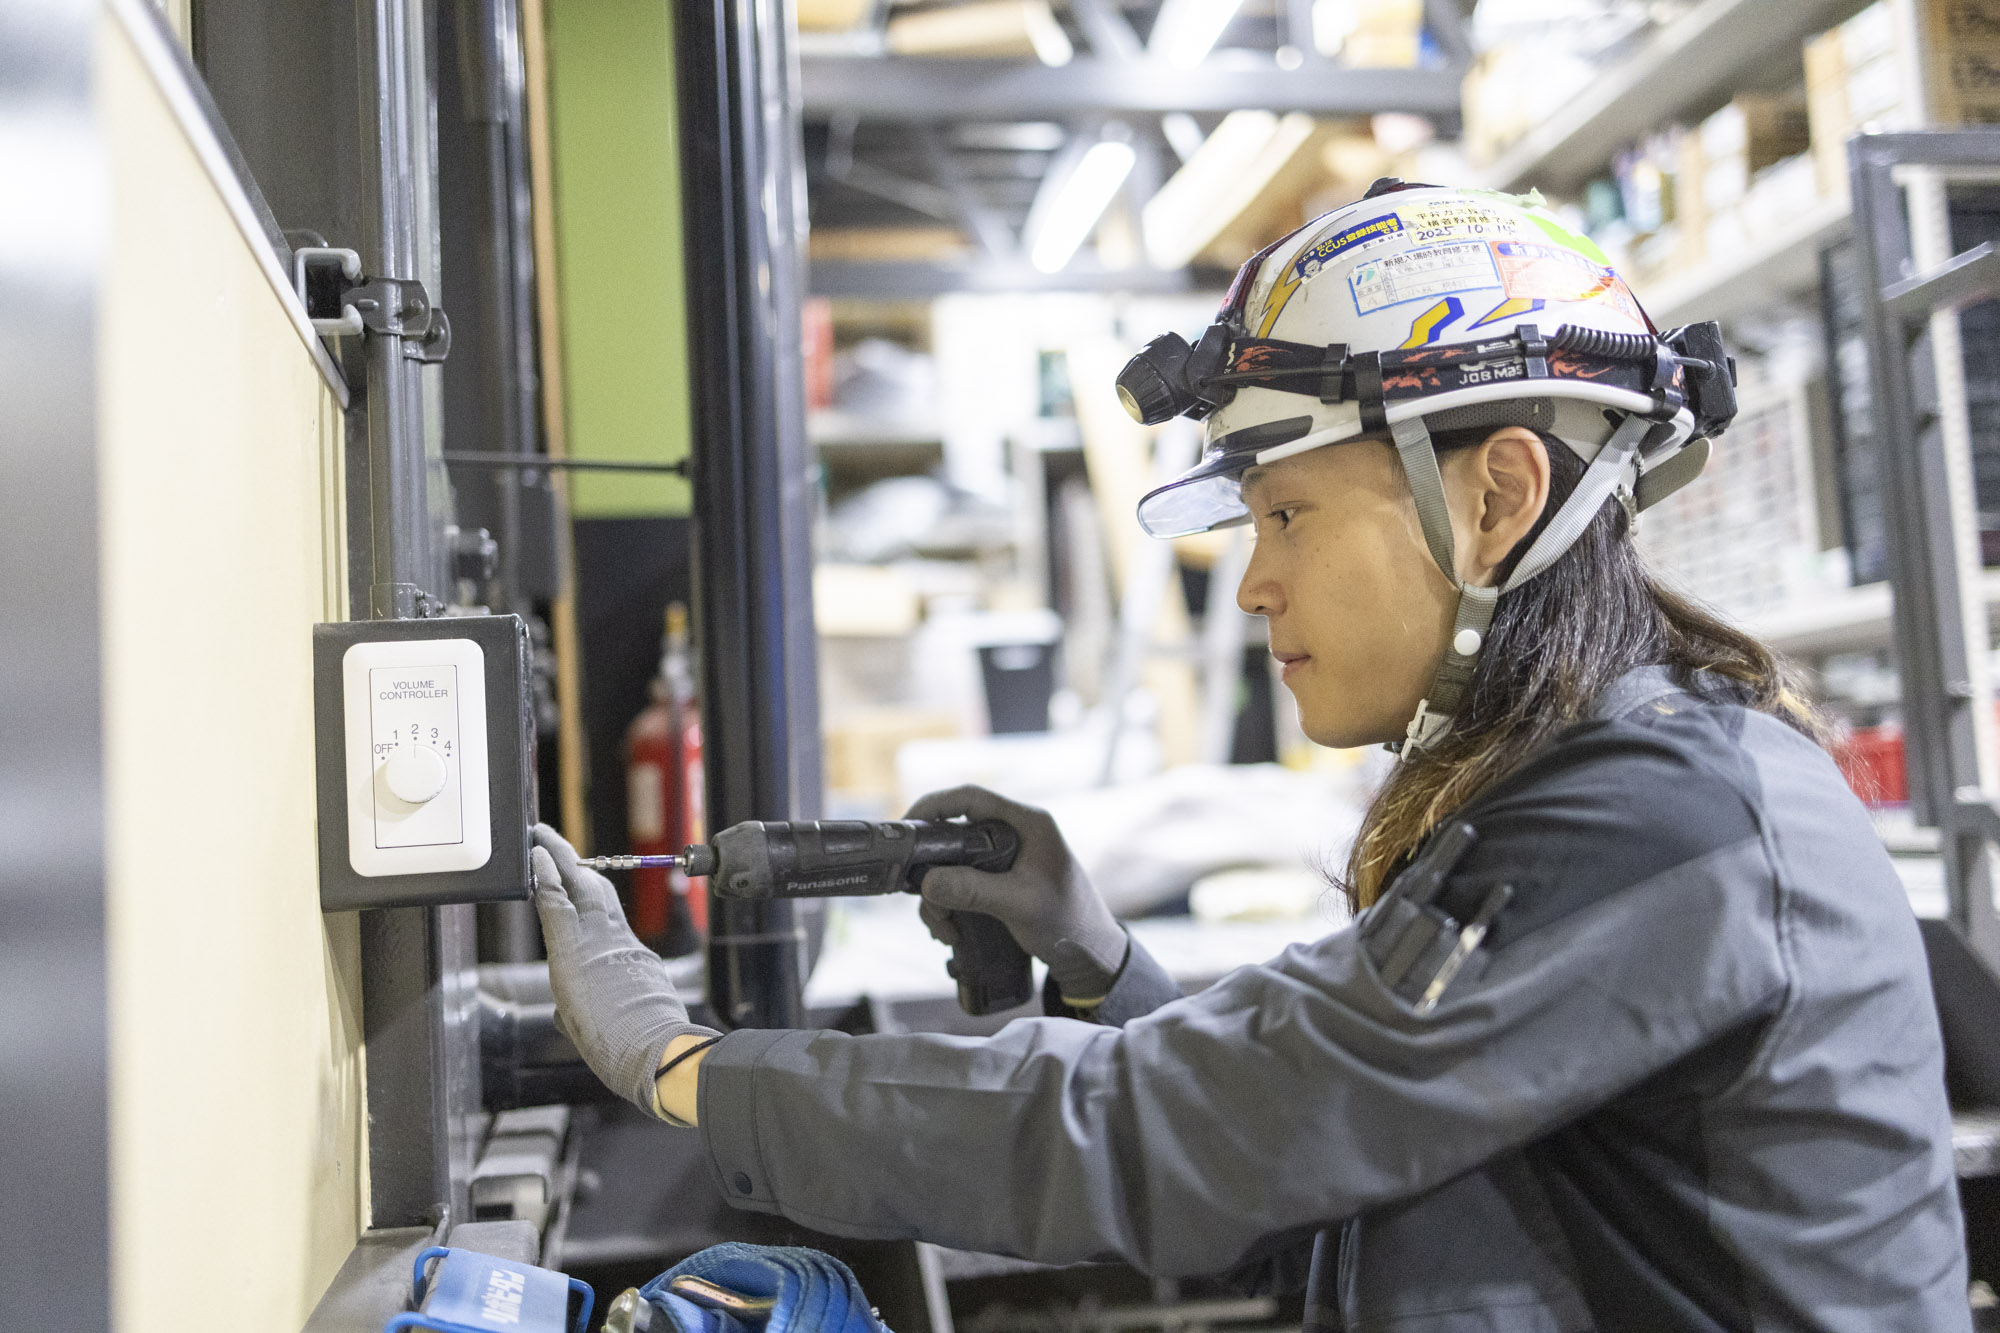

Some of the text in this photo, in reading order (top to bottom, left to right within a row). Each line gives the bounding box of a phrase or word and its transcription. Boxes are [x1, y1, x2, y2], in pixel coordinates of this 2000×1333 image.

[1381, 225, 1399, 234] です
[1416, 226, 1452, 241] 2025
[1459, 370, 1492, 385] JOB
[393, 680, 435, 690] VOLUME
[379, 689, 448, 700] CONTROLLER
[374, 723, 452, 754] OFF 1 2 3 4
[786, 874, 869, 891] Panasonic
